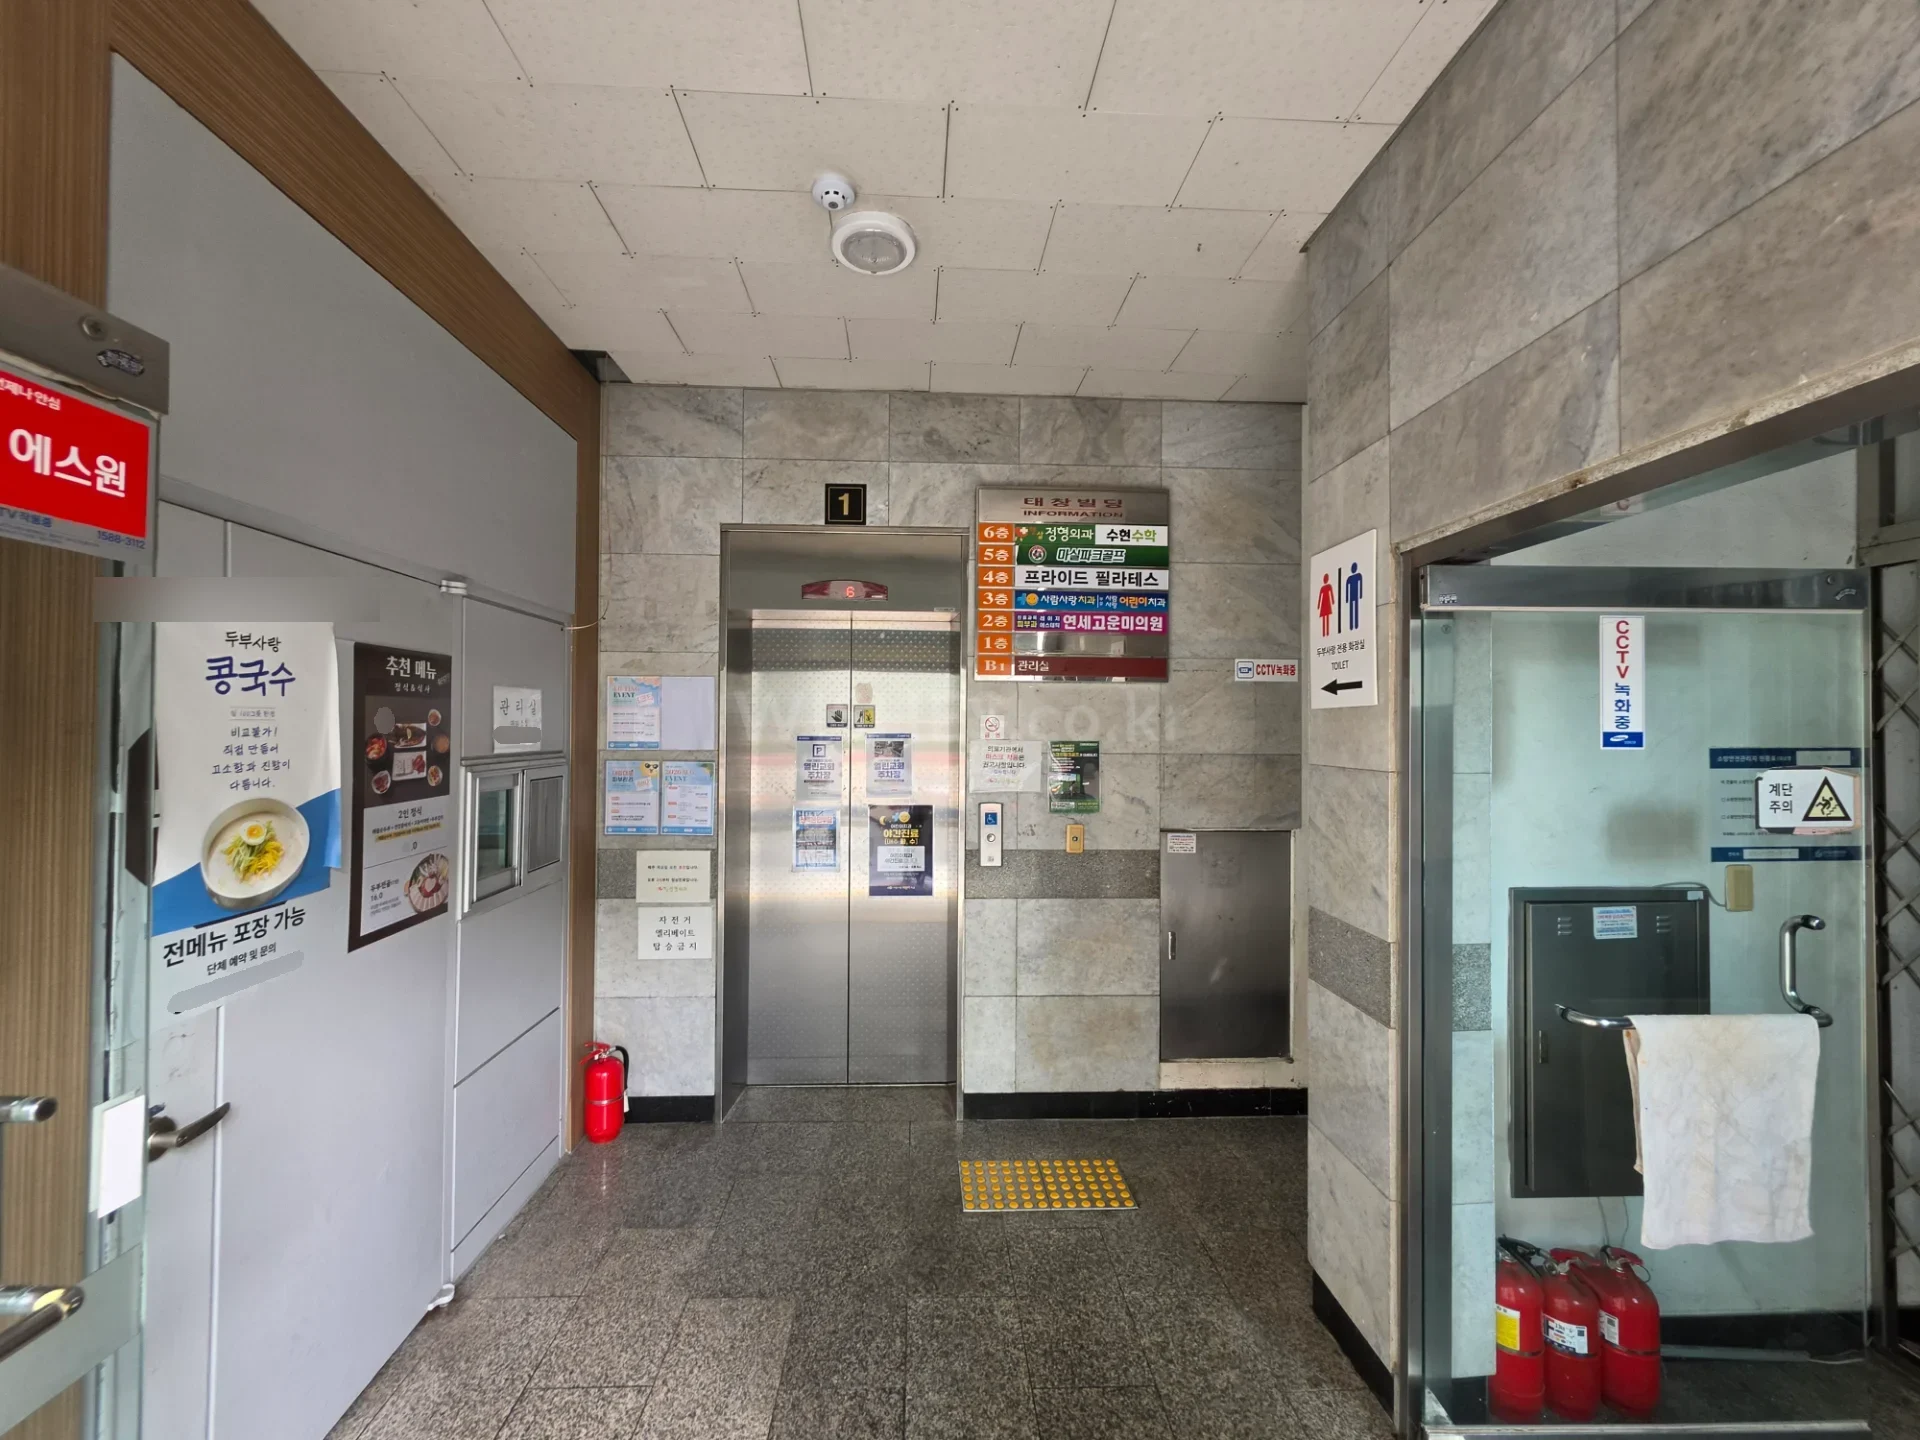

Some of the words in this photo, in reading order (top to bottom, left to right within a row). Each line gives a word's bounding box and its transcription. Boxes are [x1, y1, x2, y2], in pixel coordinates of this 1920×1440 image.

[9, 428, 127, 498] 에스원
[838, 493, 850, 516] 1
[1023, 510, 1123, 518] INFORMATION
[983, 526, 1010, 539] 6층
[1106, 528, 1157, 542] 수현수학
[97, 530, 147, 550] 1588-3112
[983, 548, 1010, 561] 5층
[1056, 548, 1126, 563] 마실파크골프
[983, 570, 1010, 583] 4층
[1024, 570, 1089, 586] 프라이드
[1095, 571, 1159, 587] 필라테스
[845, 586, 855, 598] 6
[983, 592, 1009, 605] 3층
[982, 614, 1009, 627] 2층
[1063, 614, 1163, 632] 연세고운미의원
[225, 631, 282, 654] 두부사랑
[984, 636, 1008, 649] 1층
[1316, 645, 1336, 657] 두부사랑
[1348, 639, 1365, 652] 화장실
[386, 655, 411, 678] 추천
[414, 660, 438, 681] 메뉴
[1018, 660, 1049, 672] 관리실
[1331, 660, 1349, 671] TOILET
[205, 655, 297, 697] 콩국수
[807, 770, 831, 780] 주차장
[877, 770, 901, 780] 주차장
[1769, 783, 1793, 797] 계단
[1769, 799, 1793, 815] 주의
[883, 828, 919, 839] 야간진료
[163, 931, 229, 970] 전메뉴
[232, 916, 271, 946] 포장
[273, 904, 307, 932] 가능
[653, 942, 697, 952] 탑승금지
[206, 957, 228, 976] 단체
[228, 949, 248, 969] 예약
[249, 946, 259, 961] 및
[259, 941, 277, 959] 문의
